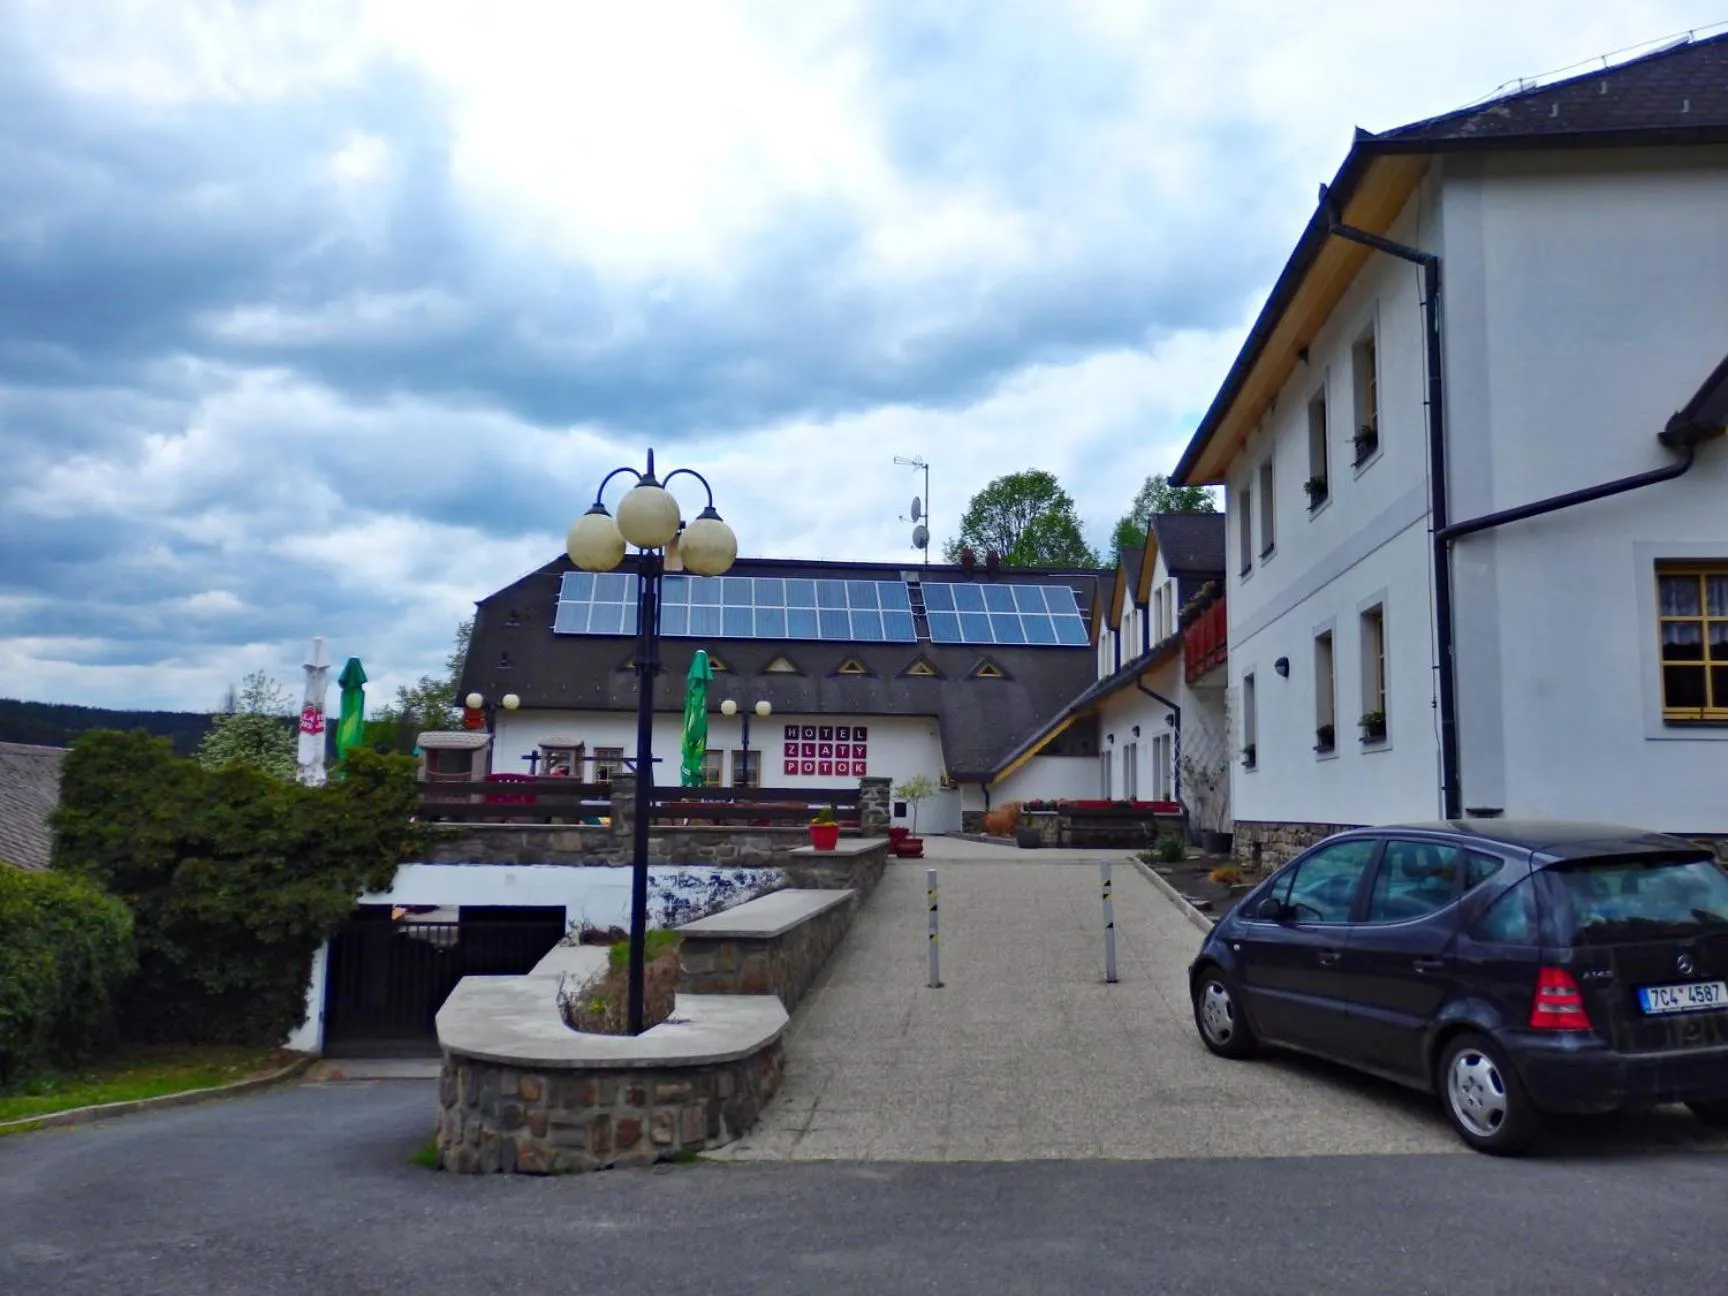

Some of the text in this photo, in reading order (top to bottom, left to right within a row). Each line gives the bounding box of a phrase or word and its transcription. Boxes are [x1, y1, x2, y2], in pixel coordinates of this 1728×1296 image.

[788, 728, 864, 739] HOTEL
[788, 763, 864, 773] POTOK
[1650, 984, 1719, 1007] 7C4 4587
